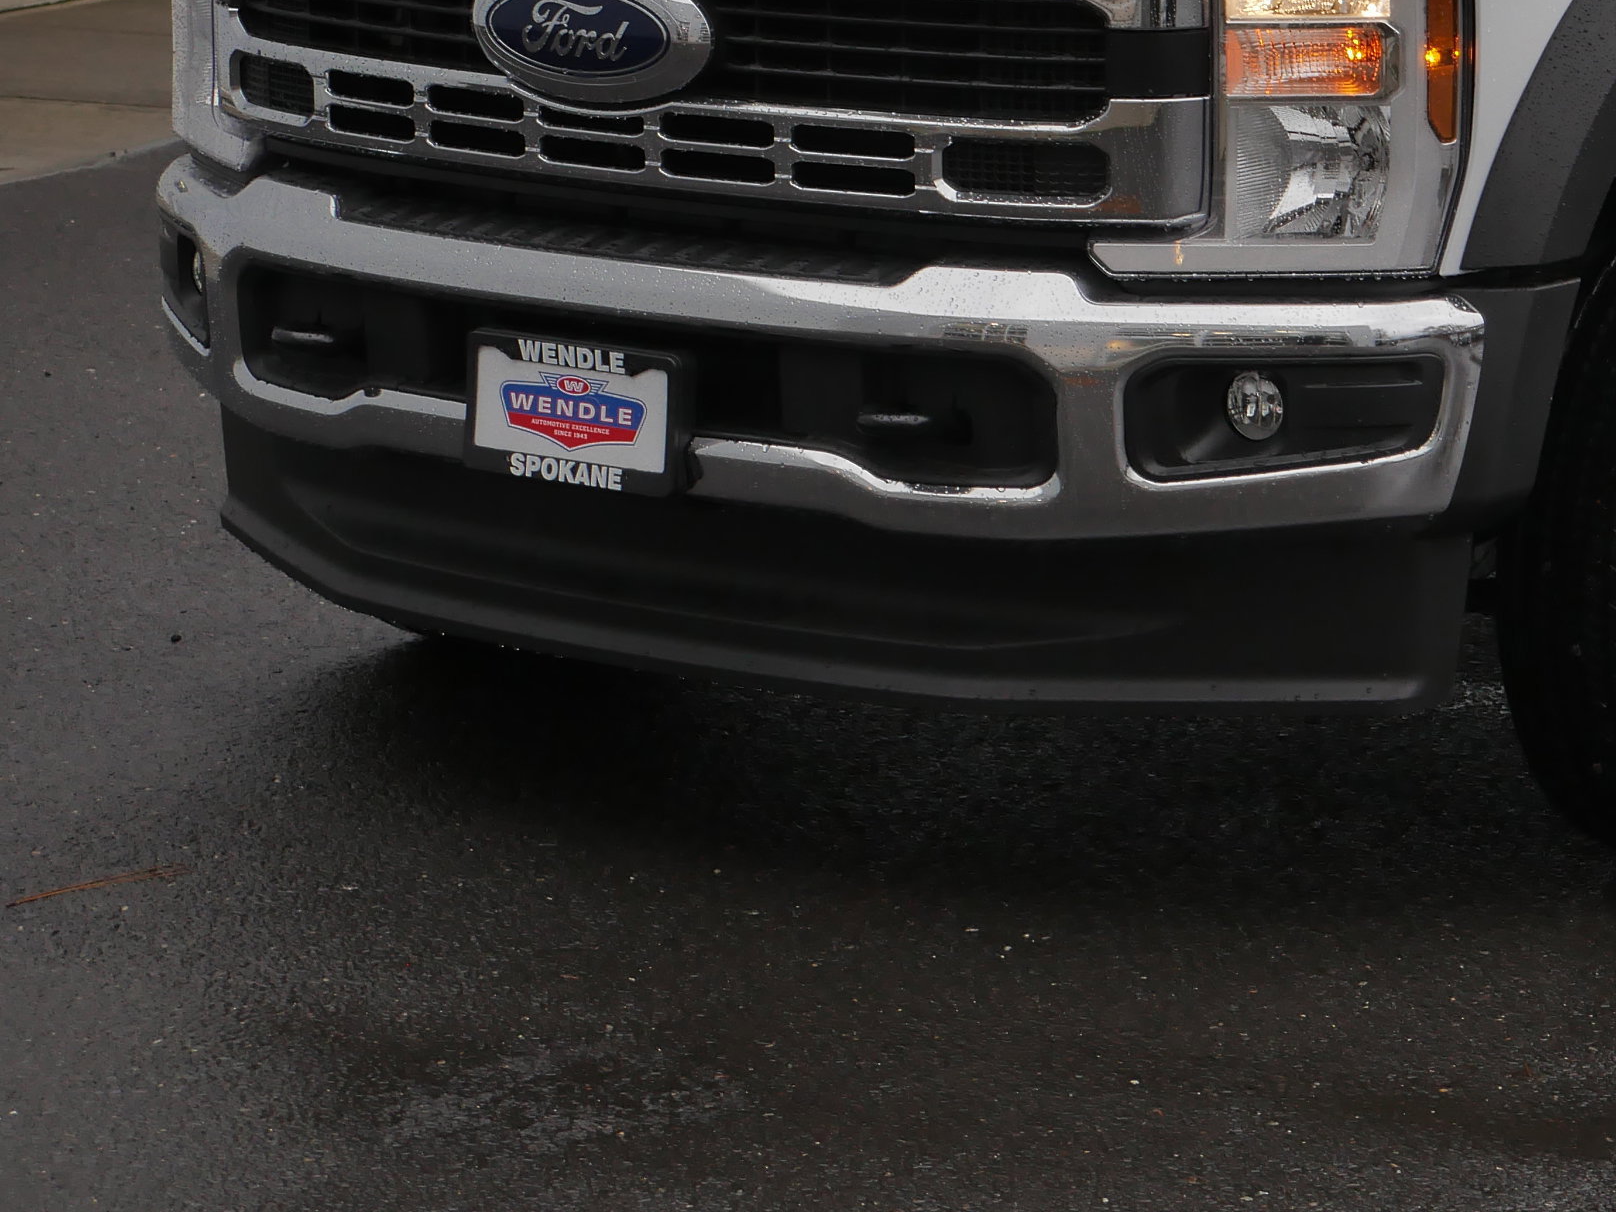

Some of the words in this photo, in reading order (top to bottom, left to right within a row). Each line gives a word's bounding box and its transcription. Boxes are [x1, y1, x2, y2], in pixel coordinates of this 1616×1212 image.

[517, 339, 626, 374] WENDLE
[510, 392, 633, 426] WENDLE
[531, 418, 570, 429] AUTOMOTIVE
[571, 424, 610, 436] EXCELLENCE
[554, 429, 572, 438] SINCE
[509, 452, 623, 491] SPOKANE
